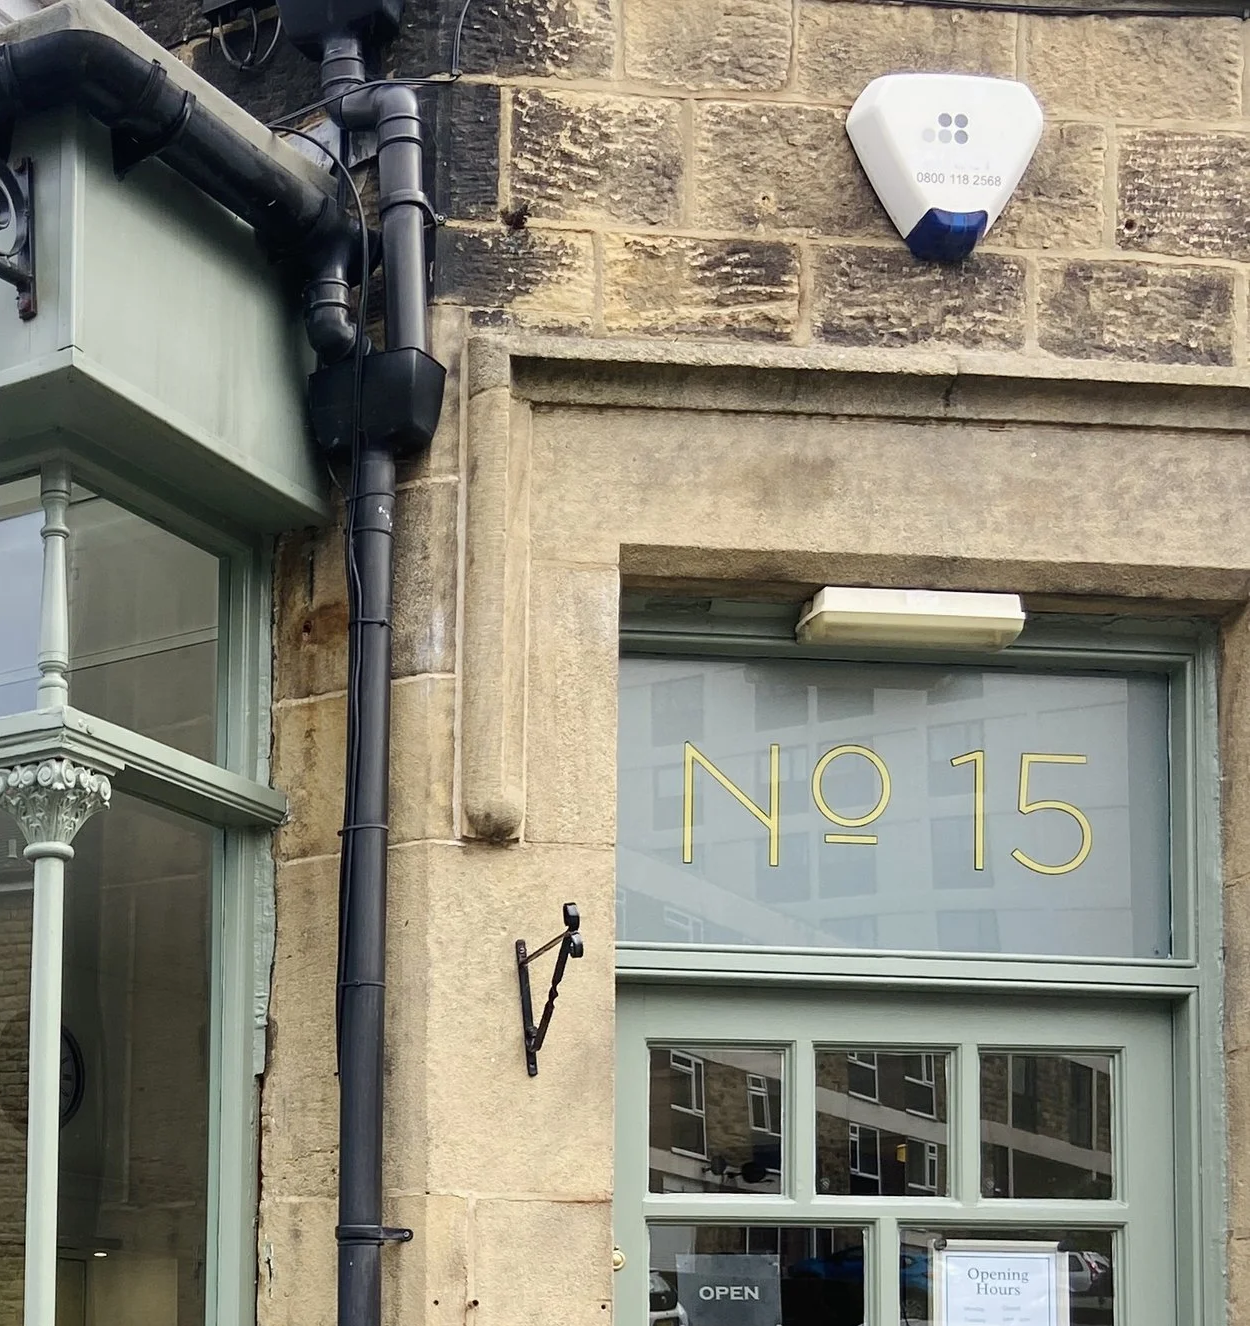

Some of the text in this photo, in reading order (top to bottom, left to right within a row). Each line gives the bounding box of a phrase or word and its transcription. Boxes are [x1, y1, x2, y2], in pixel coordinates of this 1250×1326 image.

[916, 171, 1002, 187] 0800 118 2568
[950, 749, 1093, 876] 15
[967, 1267, 1030, 1284] Opening
[698, 1285, 760, 1301] OPEN
[976, 1282, 1021, 1296] Hours
